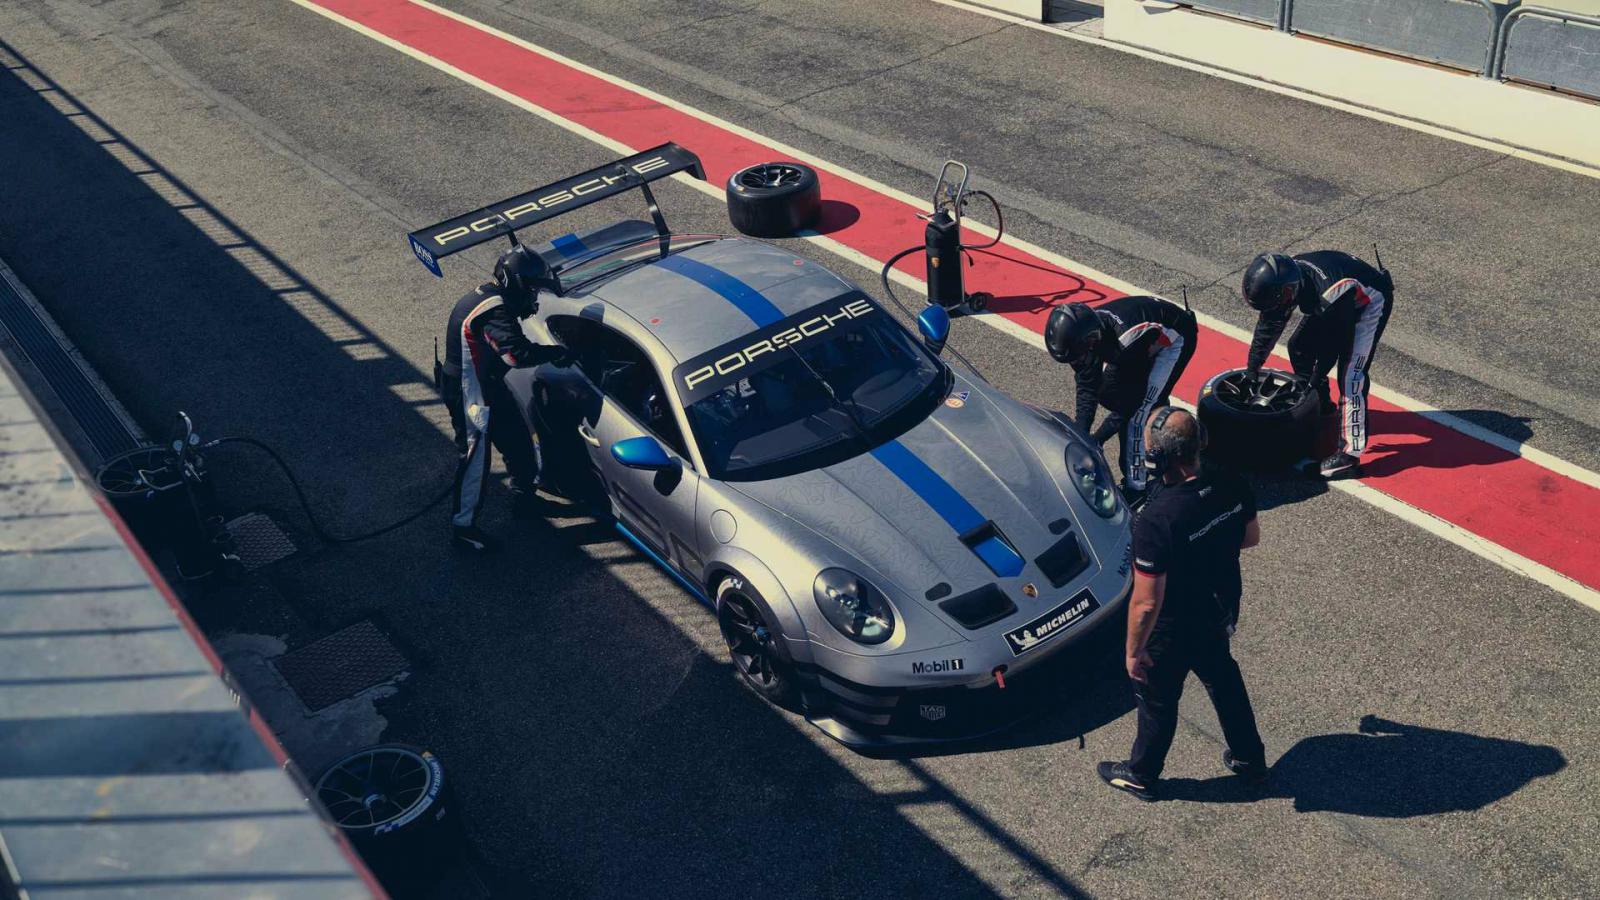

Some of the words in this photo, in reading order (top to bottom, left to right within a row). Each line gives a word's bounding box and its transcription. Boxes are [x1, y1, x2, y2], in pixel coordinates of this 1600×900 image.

[433, 156, 670, 246] PORSCHE
[684, 299, 875, 391] PORSCHE
[1352, 355, 1366, 451] PORSCHE
[1036, 598, 1090, 637] MICHELIN
[912, 659, 949, 674] Mobil
